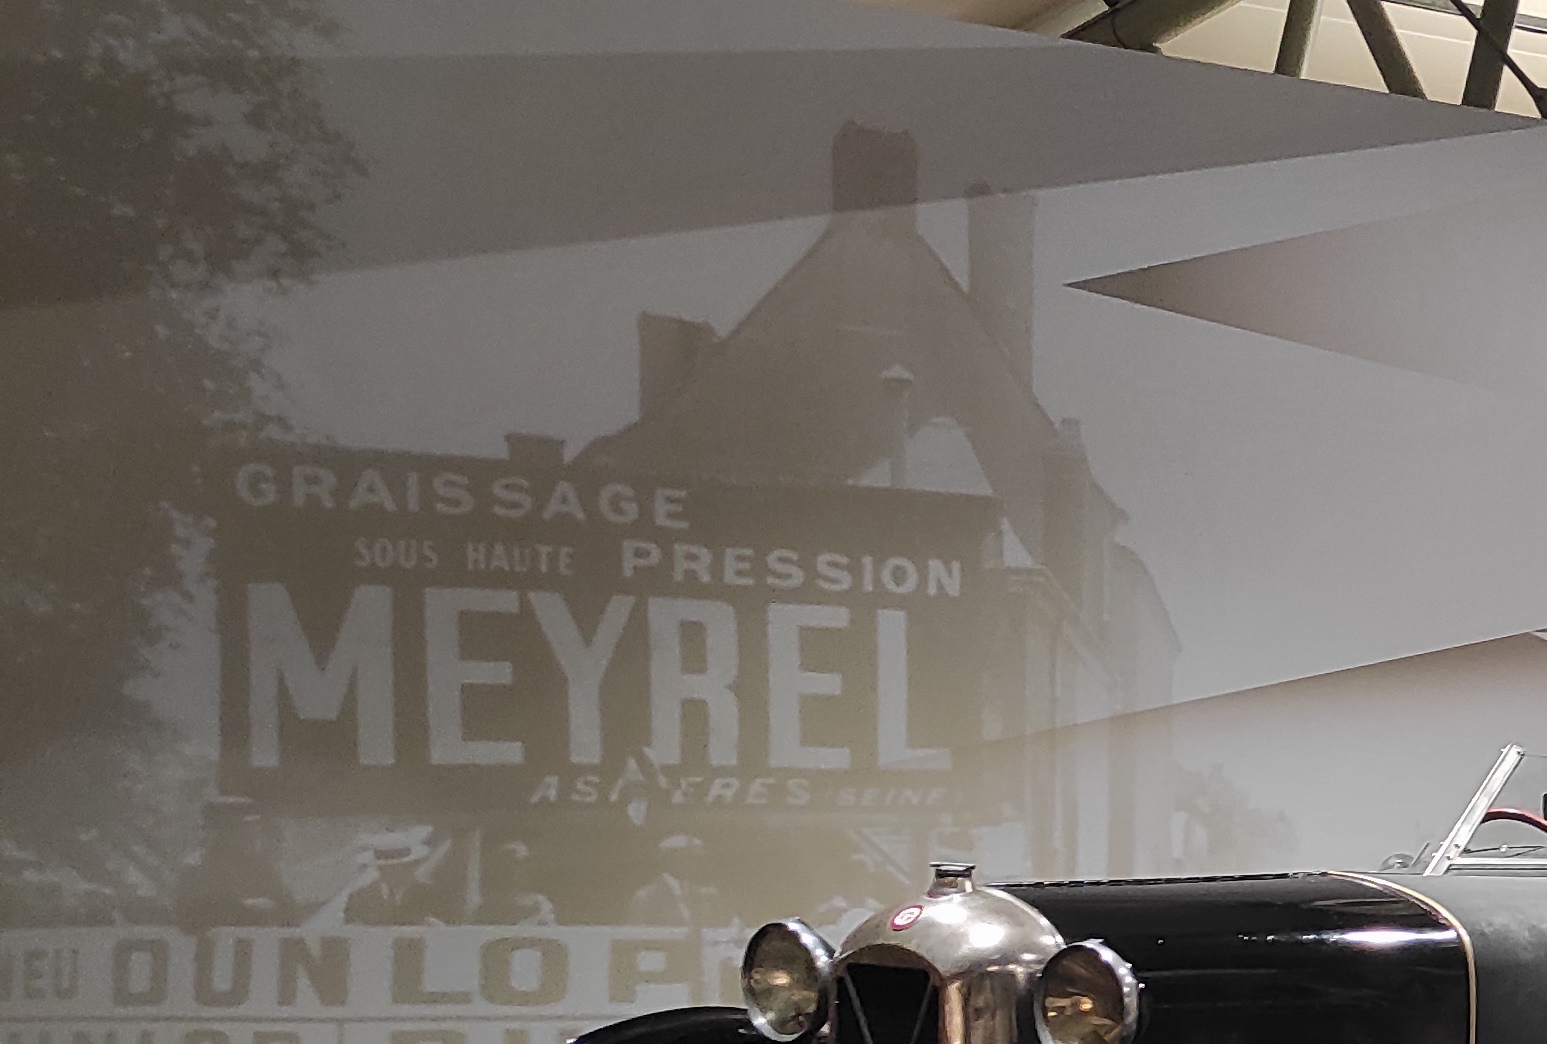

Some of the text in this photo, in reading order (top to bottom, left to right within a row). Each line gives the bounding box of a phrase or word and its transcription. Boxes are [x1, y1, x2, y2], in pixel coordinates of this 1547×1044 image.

[235, 462, 691, 531] GRAISSAGE
[354, 536, 963, 598] SOUS HAUTE PRESSION
[246, 581, 953, 771] MEYREL
[111, 935, 700, 1007] DUNLOP
